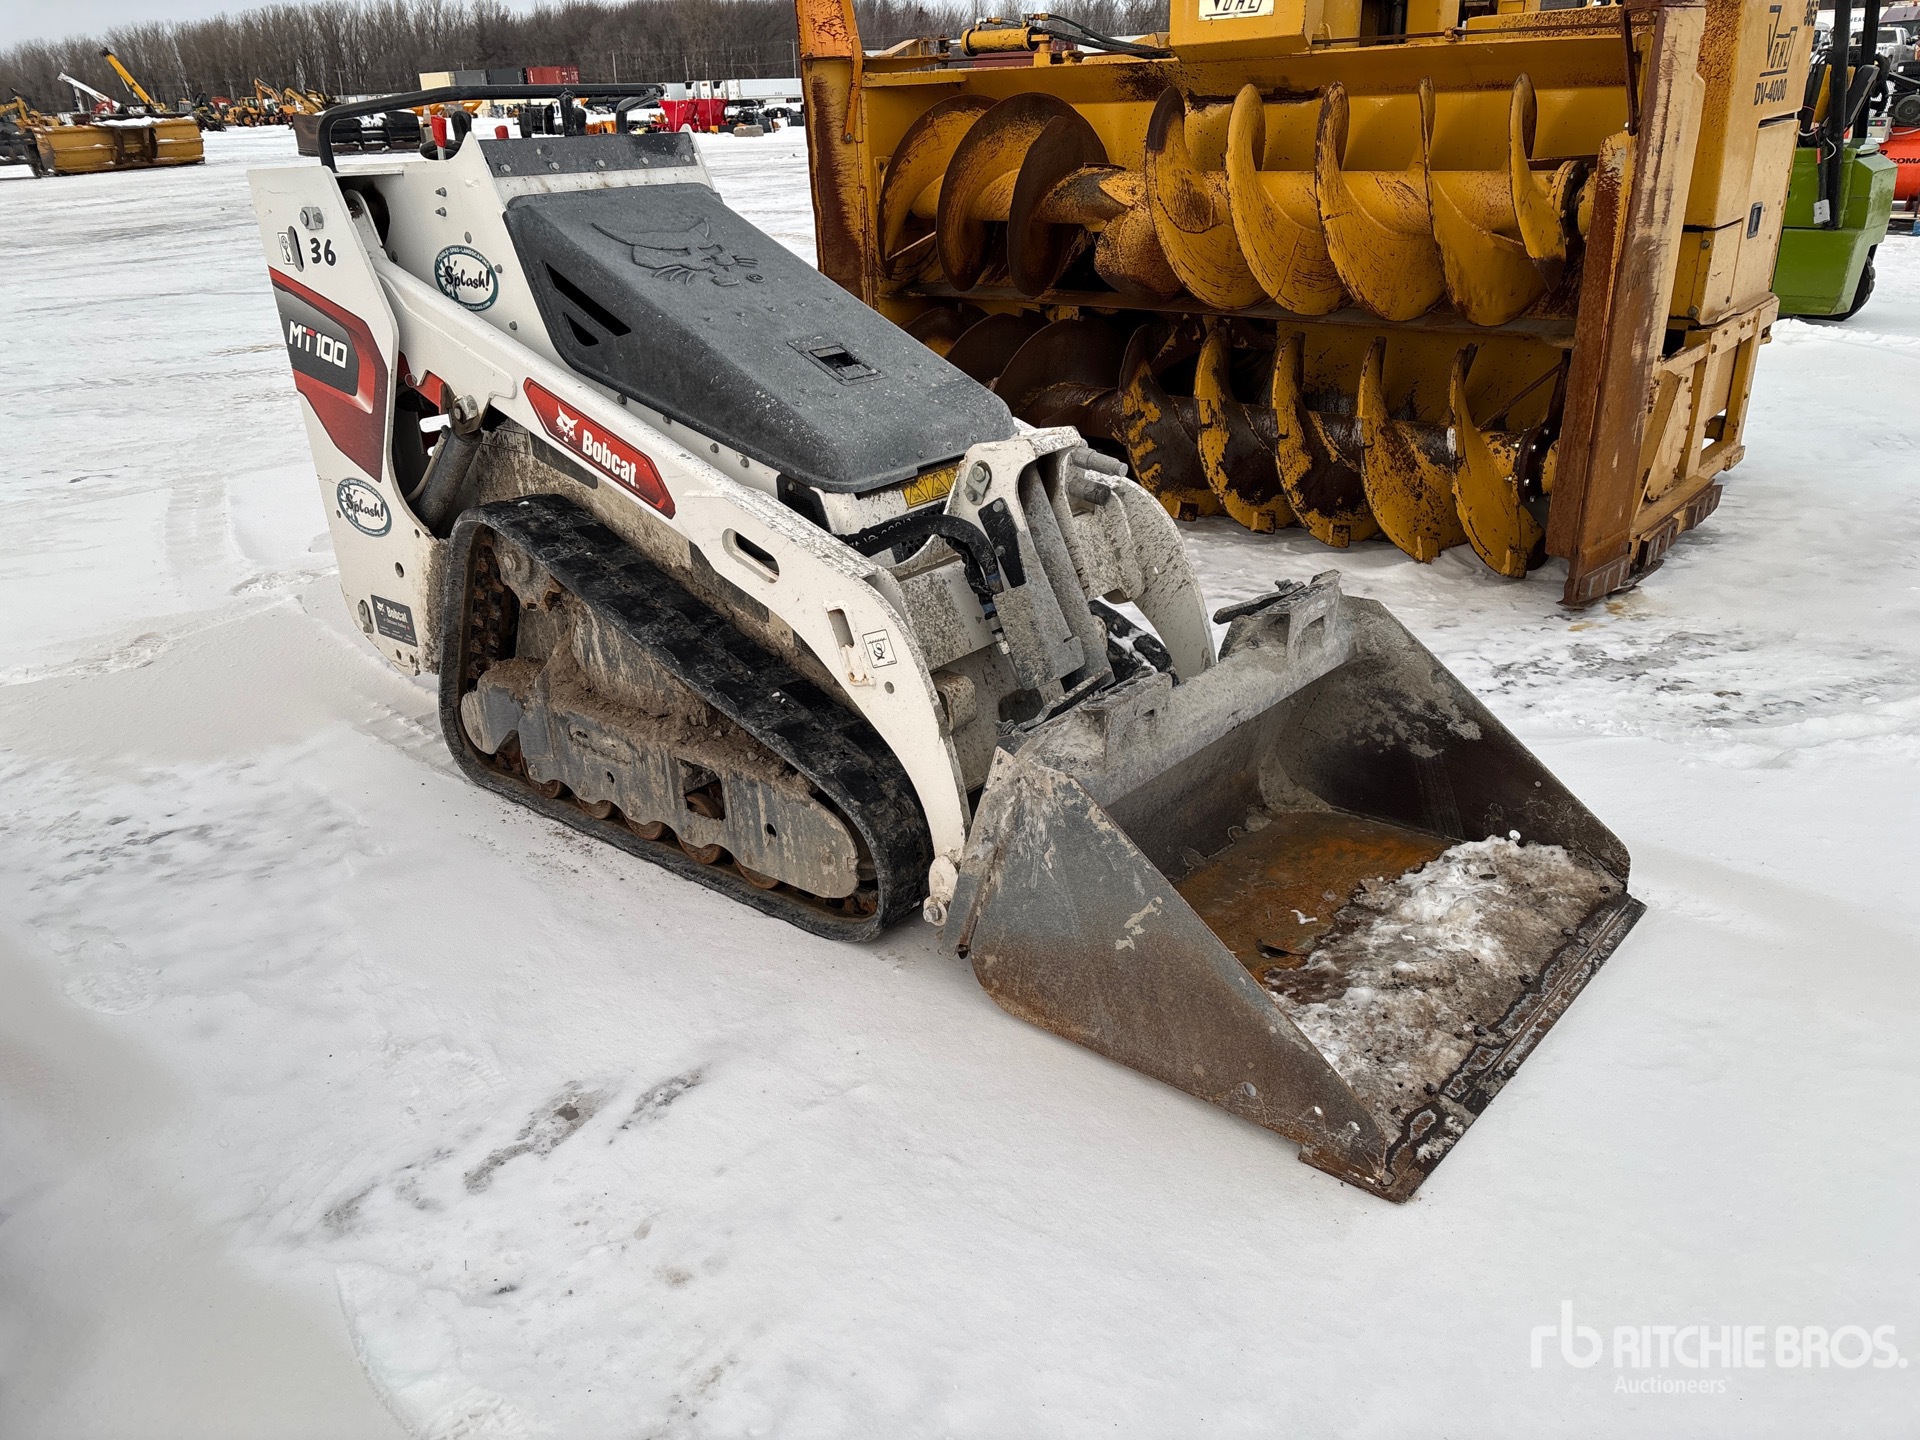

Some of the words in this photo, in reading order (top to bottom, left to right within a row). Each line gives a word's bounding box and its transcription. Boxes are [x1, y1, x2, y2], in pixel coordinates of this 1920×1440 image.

[1753, 78, 1787, 106] DV-4000
[309, 237, 337, 267] 36
[444, 265, 490, 291] Splash!
[289, 320, 348, 369] MT100
[582, 429, 637, 487] Bobcat
[345, 493, 384, 521] Splash!
